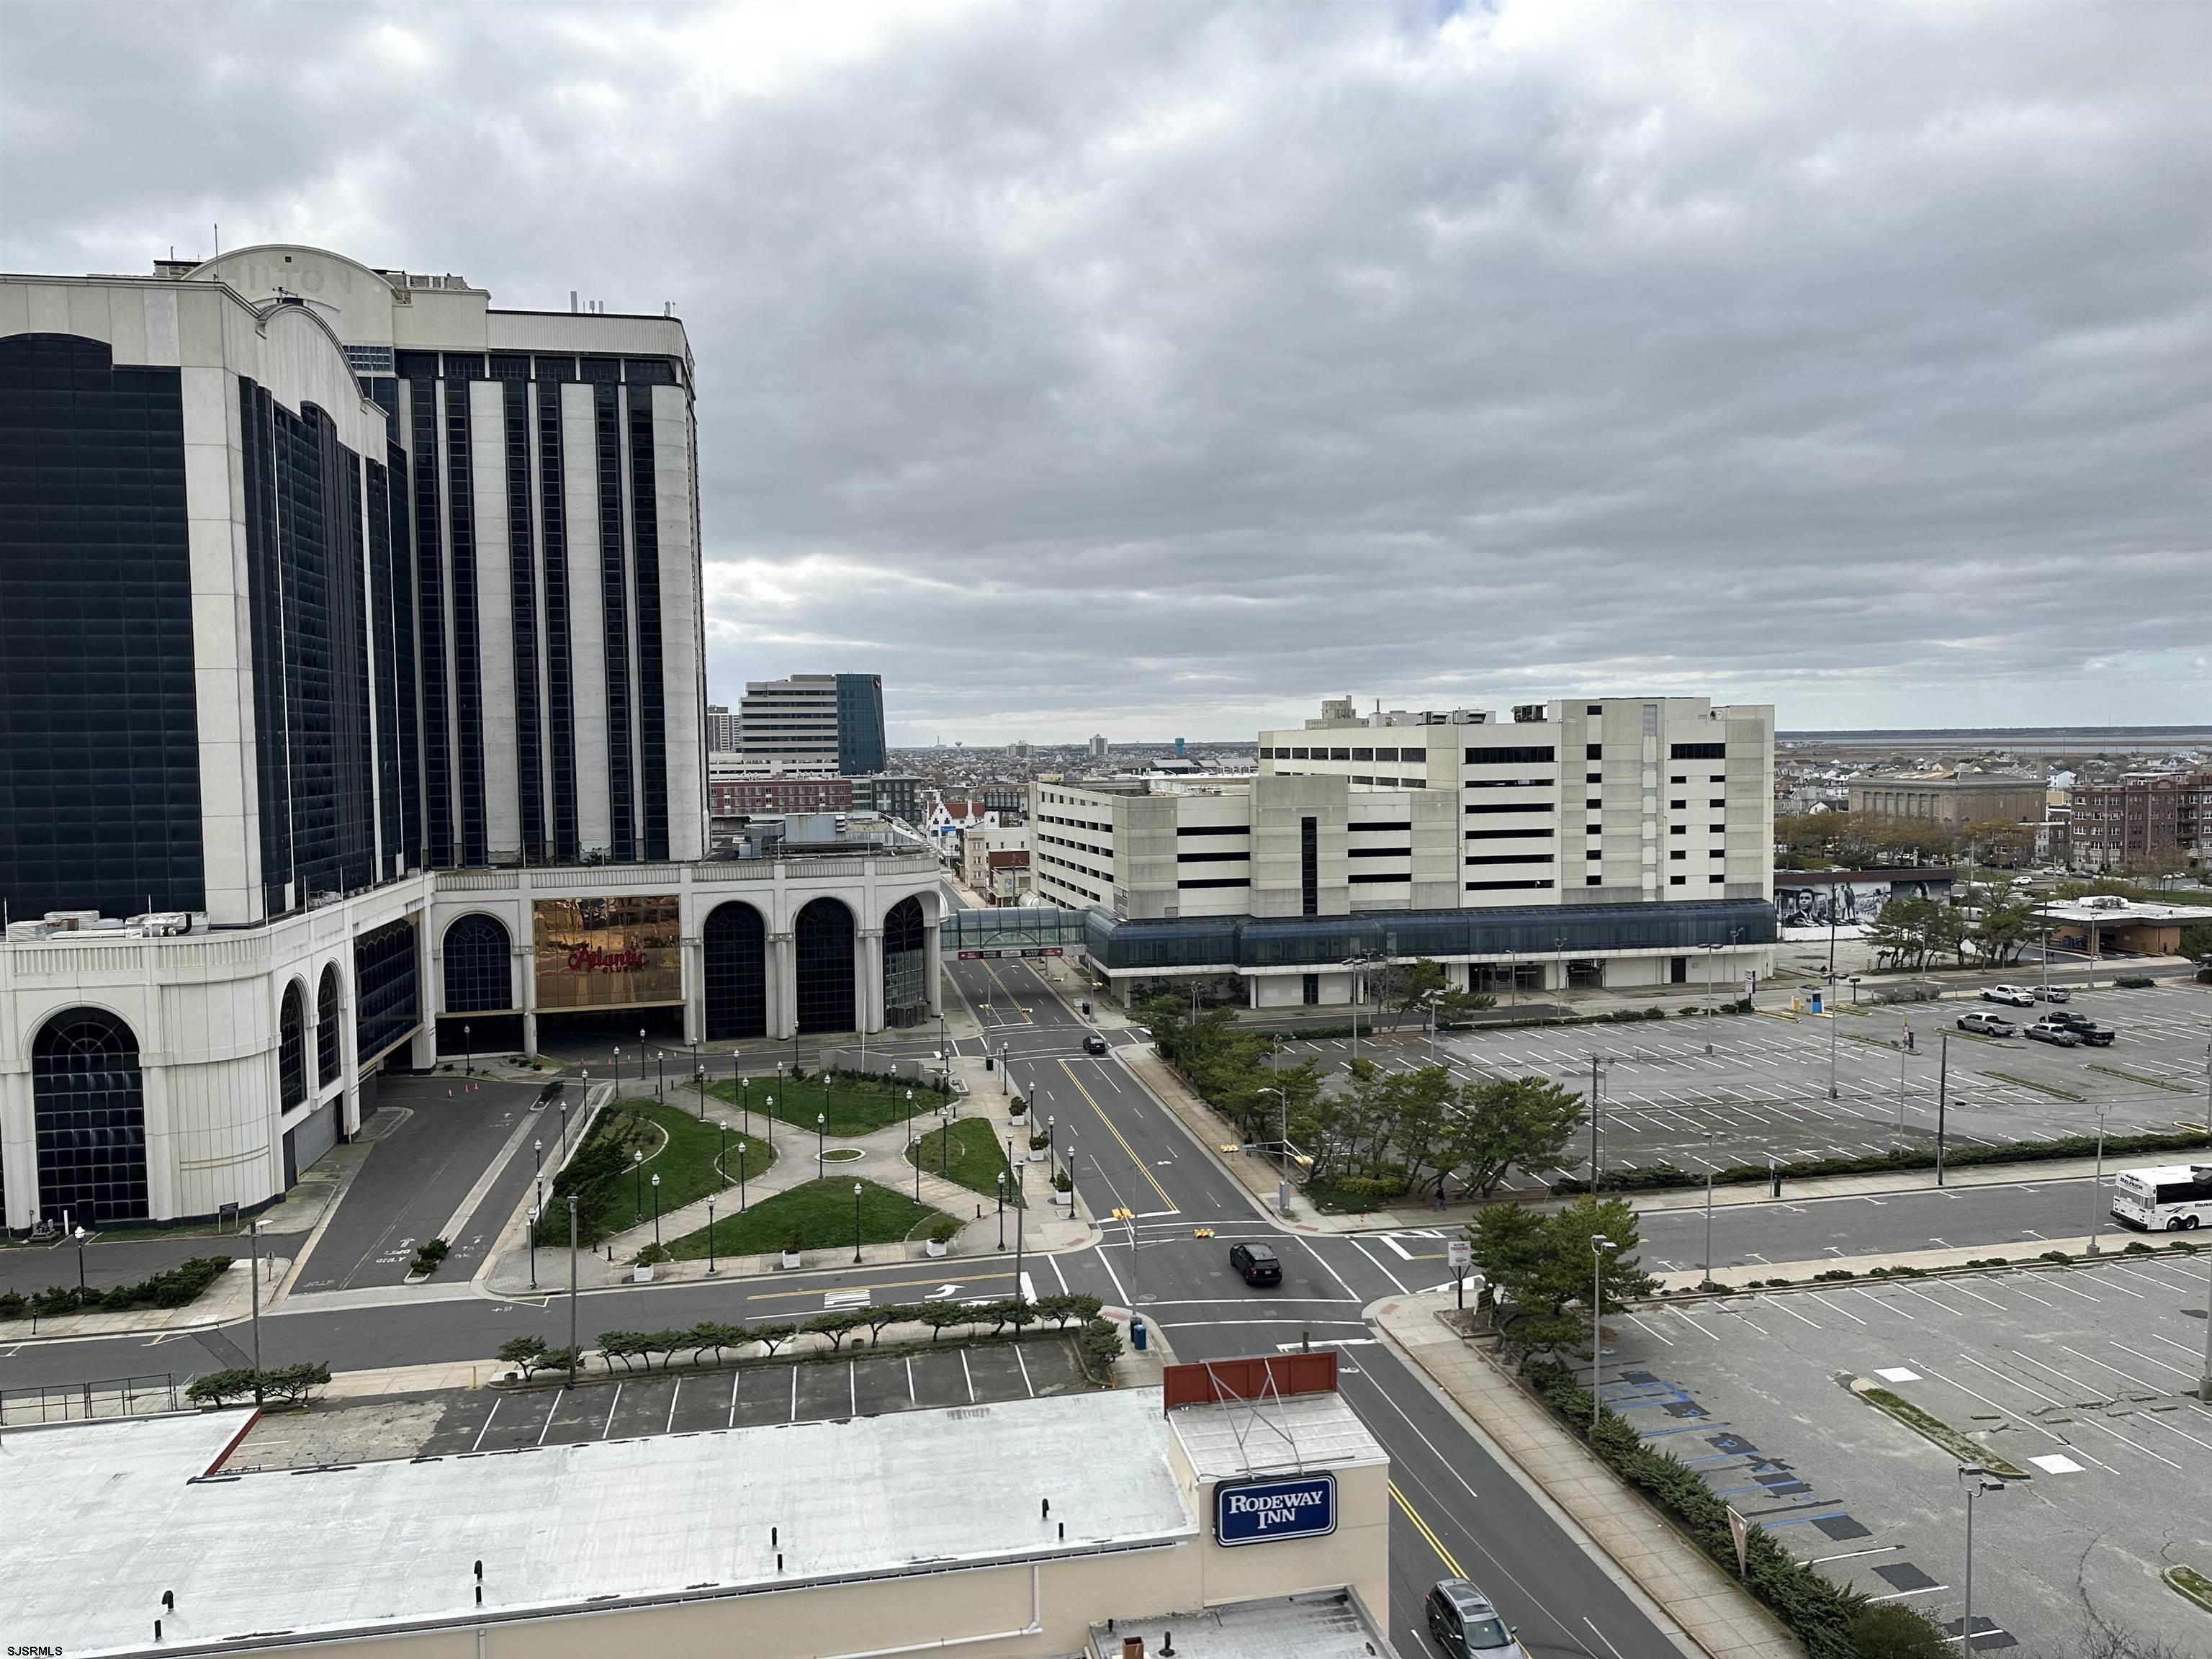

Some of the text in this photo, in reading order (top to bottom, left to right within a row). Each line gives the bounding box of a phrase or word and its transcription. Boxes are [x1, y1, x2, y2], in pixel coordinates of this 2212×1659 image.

[567, 945, 649, 973] Atlantic
[1228, 1491, 1323, 1514] RODEWAY
[1257, 1508, 1296, 1529] INN
